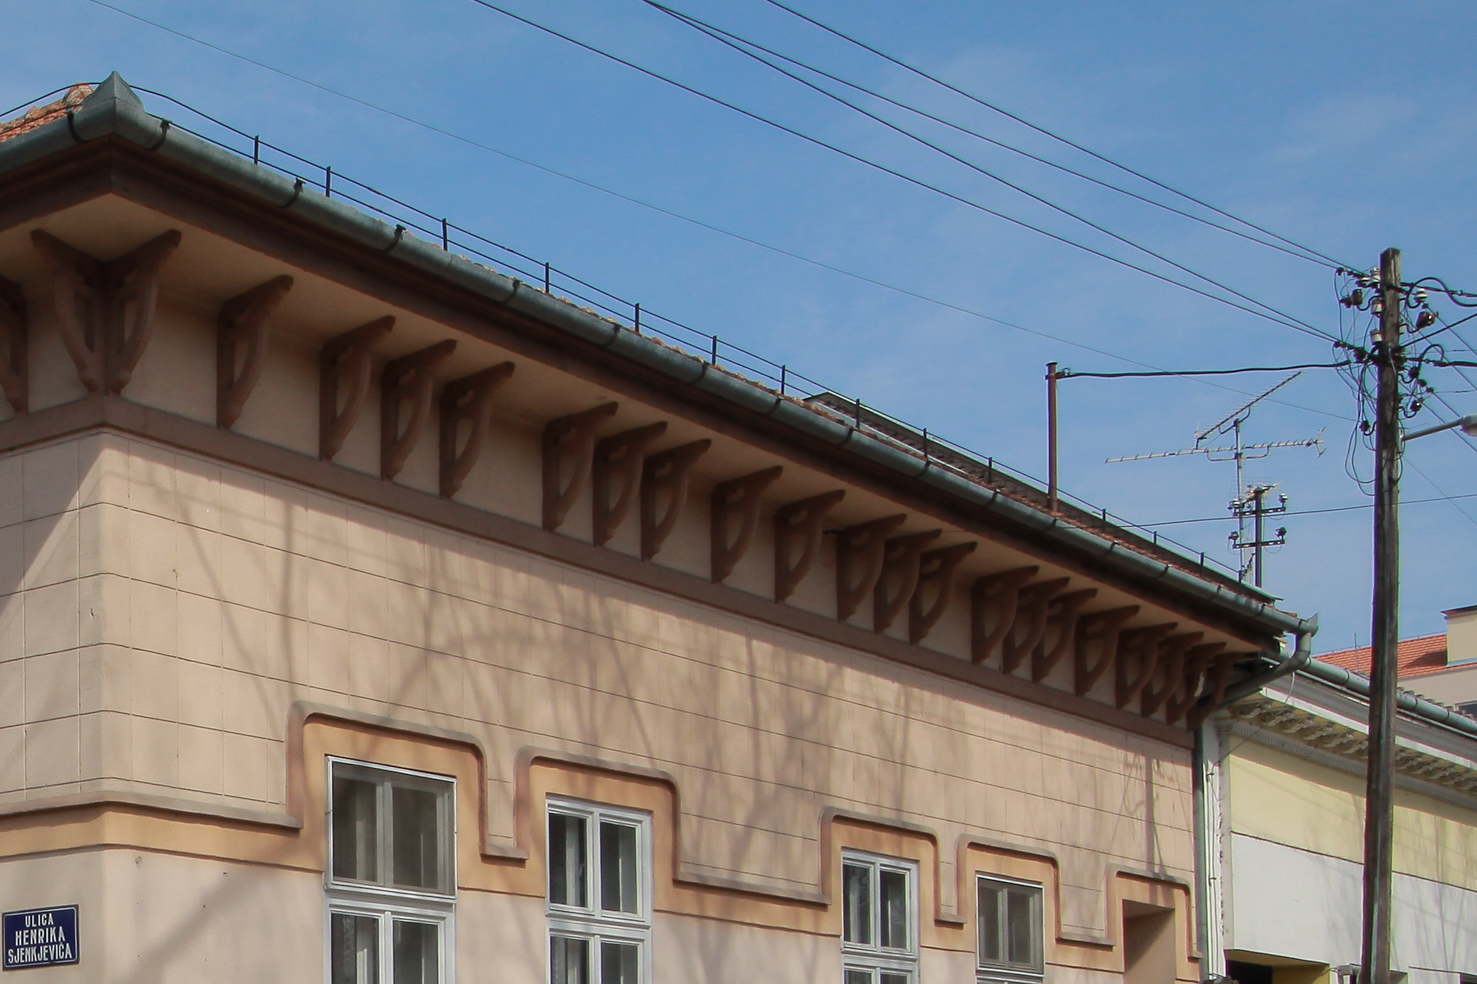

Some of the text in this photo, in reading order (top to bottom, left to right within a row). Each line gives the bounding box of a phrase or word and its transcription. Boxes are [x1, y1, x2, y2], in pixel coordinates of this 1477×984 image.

[25, 913, 54, 927] ULICA
[15, 926, 65, 946] HENRIKA
[8, 942, 72, 964] SJENKJEVIČA
